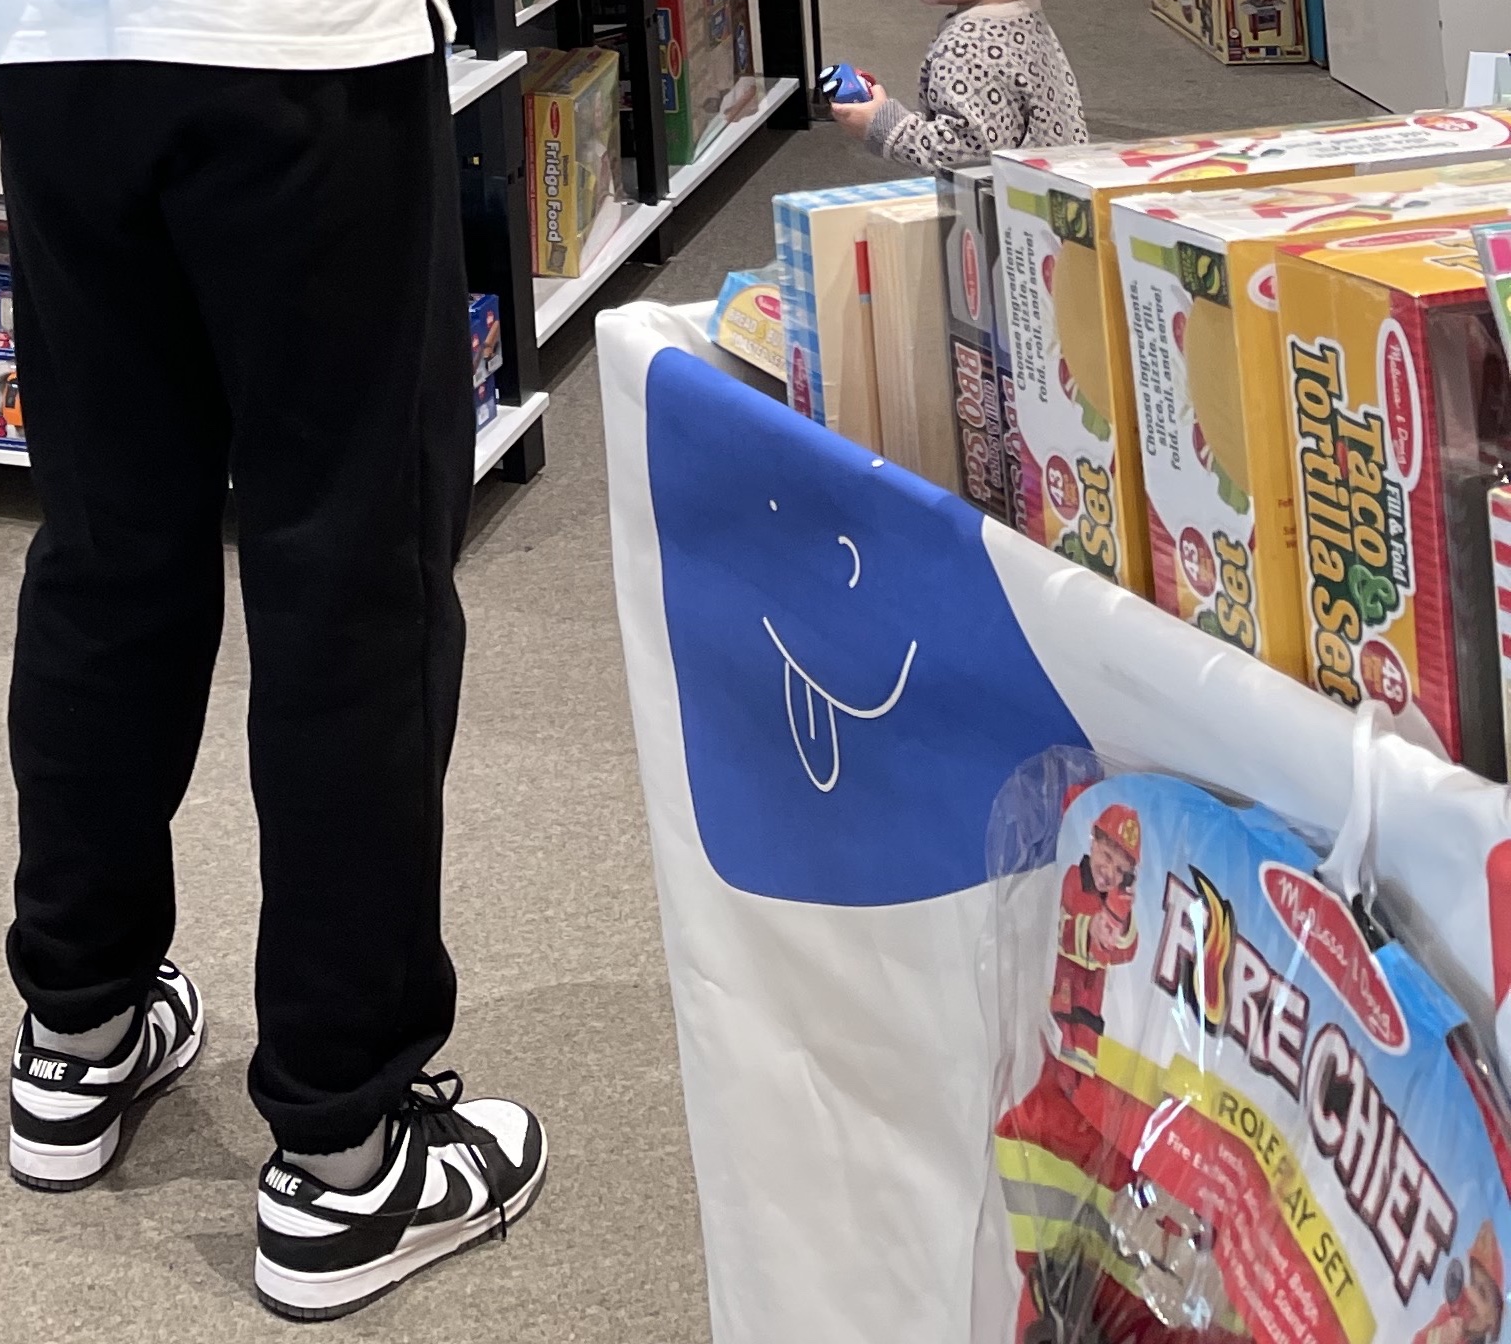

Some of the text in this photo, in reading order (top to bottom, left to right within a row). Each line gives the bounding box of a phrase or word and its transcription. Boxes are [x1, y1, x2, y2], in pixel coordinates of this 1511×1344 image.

[544, 140, 563, 243] Fridge Food
[1024, 232, 1041, 321] and serve!
[1150, 285, 1167, 345] serve!
[1012, 332, 1026, 391] Choose
[1159, 349, 1172, 382] and
[1390, 344, 1404, 412] Melissa
[954, 341, 991, 501] BBQ Set
[1141, 392, 1157, 457] Choose
[1048, 467, 1064, 507] 43
[1076, 456, 1118, 572] Set
[1335, 410, 1400, 626] Taco &
[1291, 338, 1362, 708] Tortilla Set
[1386, 484, 1410, 590] Fill & Fold
[1181, 539, 1199, 582] 43
[1211, 528, 1257, 654] Set
[1378, 656, 1404, 702] 43
[29, 1058, 68, 1081] NIKE
[1154, 865, 1311, 1104] FIRE
[1306, 1023, 1457, 1307] CHIEF
[1166, 1130, 1192, 1160] Fire
[264, 1165, 303, 1197] NIKE
[1218, 1090, 1353, 1299] ROLE PAY SET
